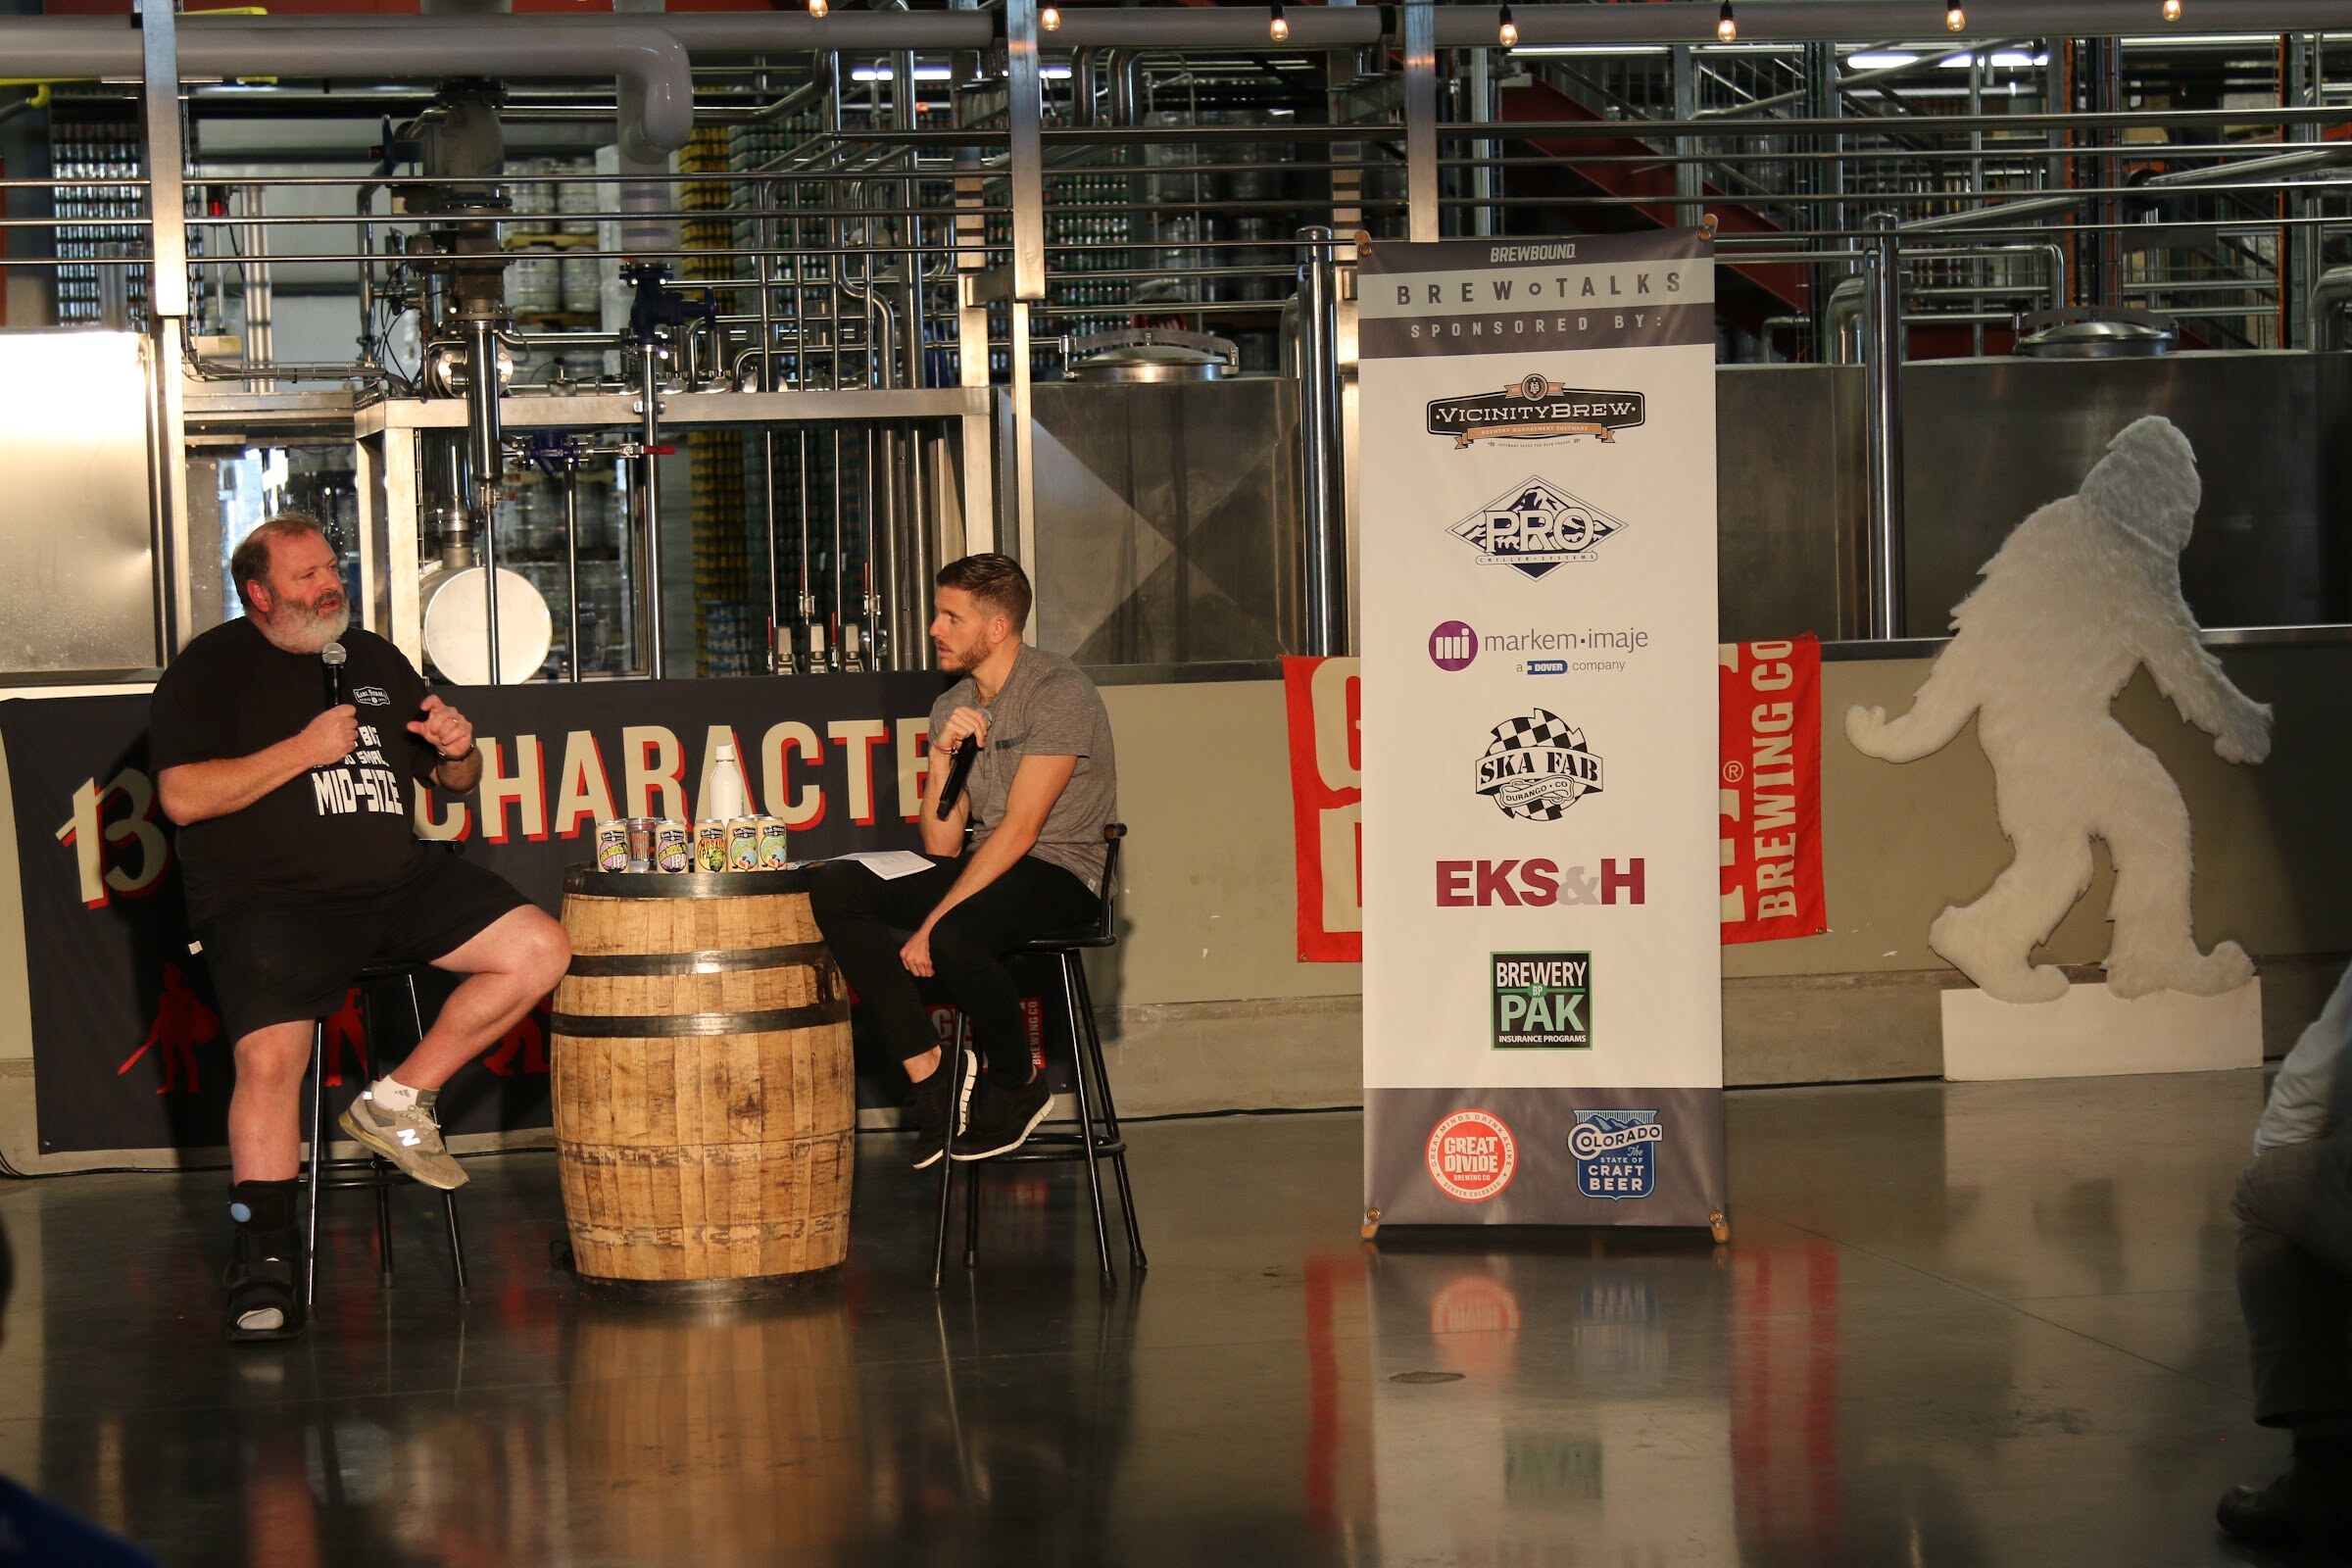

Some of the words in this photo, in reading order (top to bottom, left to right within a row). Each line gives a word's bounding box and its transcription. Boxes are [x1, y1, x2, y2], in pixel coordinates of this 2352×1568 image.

[1490, 243, 1576, 263] BREWBOUND
[1396, 280, 1513, 306] BREW
[1555, 271, 1681, 297] TALKS
[1410, 317, 1589, 338] SPONSORED
[1614, 314, 1662, 329] BY:
[1484, 507, 1594, 553] PRO
[1516, 663, 1523, 672] a
[1534, 662, 1564, 672] DOVER
[1572, 660, 1626, 673] company
[1750, 640, 1793, 692] CO
[1481, 752, 1536, 785] SKA
[1545, 752, 1598, 781] FAB
[312, 768, 404, 816] MID-SIZE
[1505, 785, 1546, 802] DURANGO
[1751, 701, 1797, 921] BREWING
[56, 767, 168, 904] 13
[1436, 858, 1645, 907] EKS&H
[1496, 961, 1587, 988] BREWERY
[1532, 985, 1543, 996] BP
[1500, 994, 1586, 1032] PAK
[1430, 1135, 1441, 1167] GREAT
[1440, 1114, 1471, 1134] MINDS
[1474, 1114, 1504, 1134] DRINK
[1502, 1136, 1512, 1166] ALIKE
[1444, 1136, 1498, 1155] GREAT
[1571, 1126, 1661, 1156] COLORADO
[1627, 1145, 1643, 1156] The
[1444, 1153, 1498, 1173] DIVIDE
[1588, 1165, 1644, 1176] CRAFT
[1444, 1182, 1467, 1197] DENVER
[1469, 1181, 1501, 1198] COLORADO
[1590, 1178, 1642, 1191] BEER
